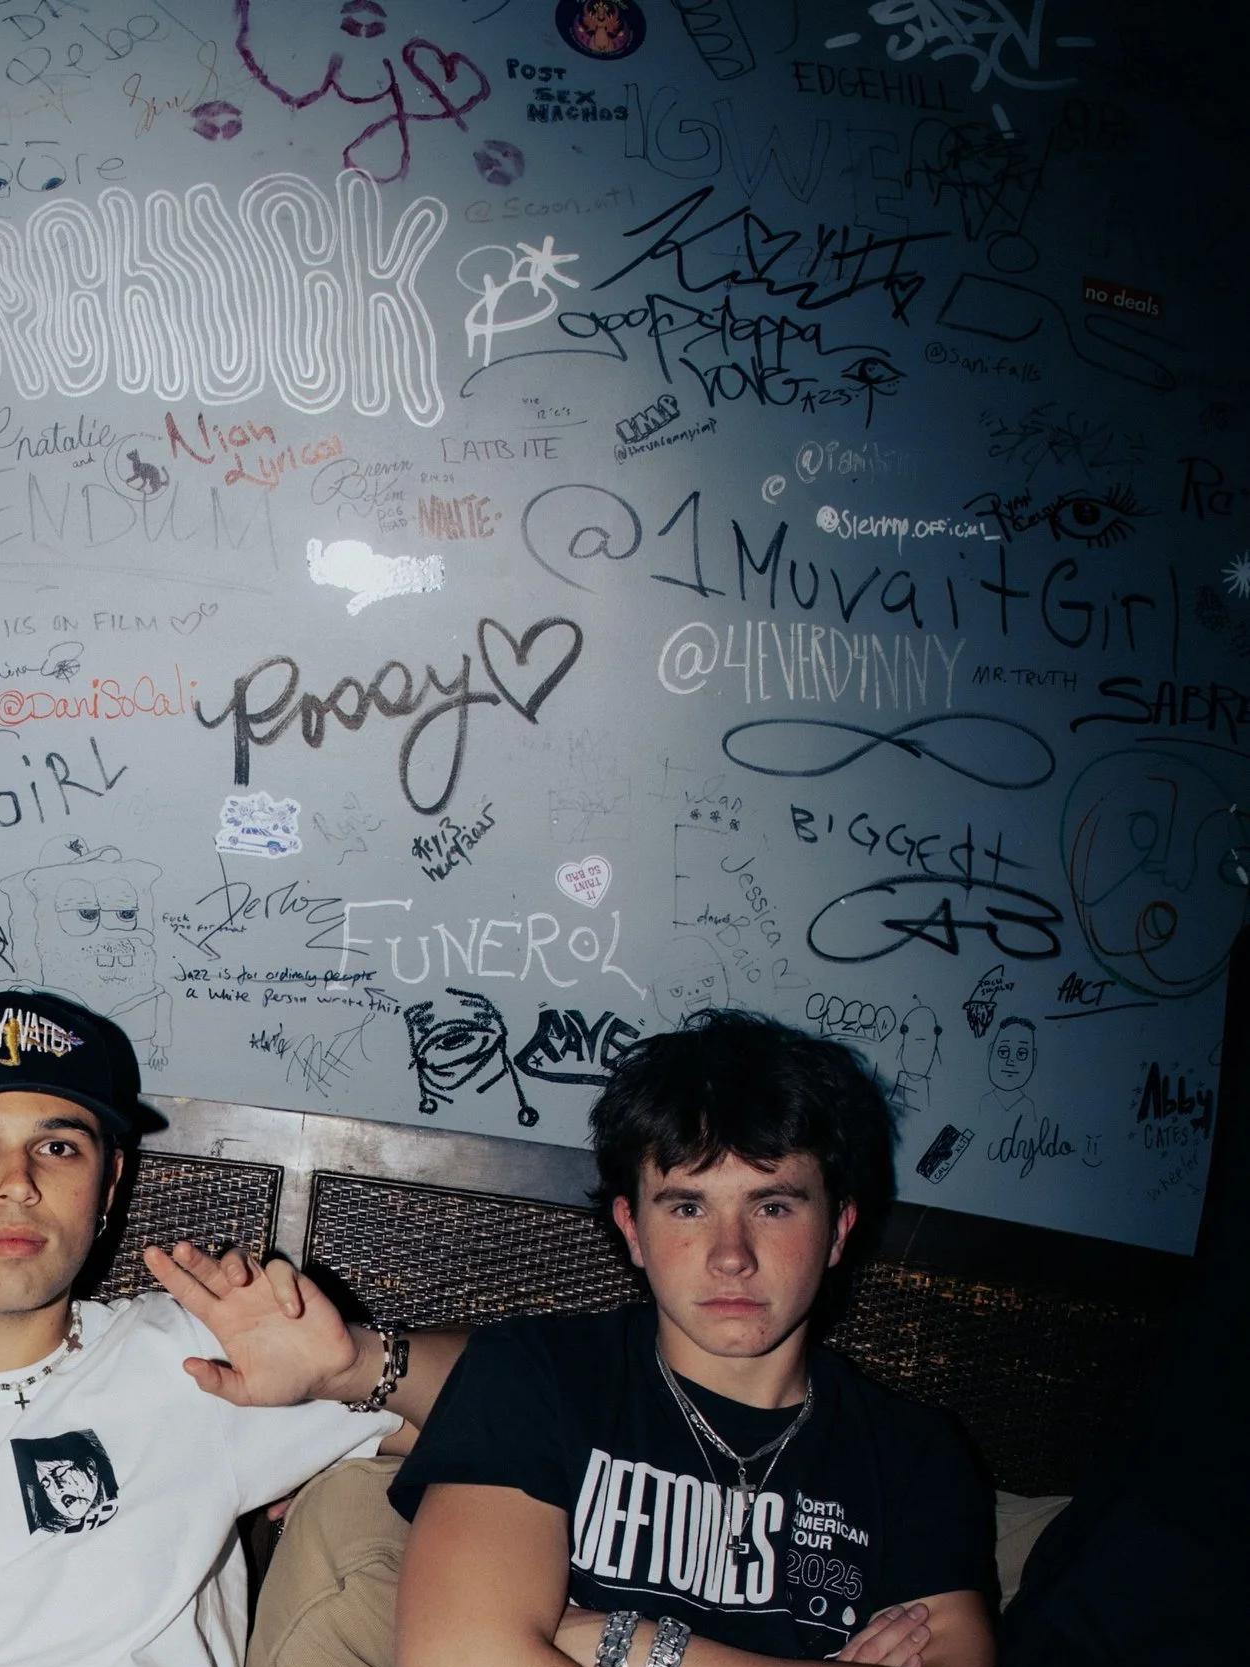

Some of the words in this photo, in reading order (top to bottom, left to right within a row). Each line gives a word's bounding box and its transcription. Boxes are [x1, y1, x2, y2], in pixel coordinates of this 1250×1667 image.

[506, 57, 566, 81] POST
[793, 60, 963, 114] EDGEHILL
[527, 103, 628, 123] NACHOS
[533, 87, 596, 105] SEX
[1085, 285, 1108, 302] no
[1113, 288, 1160, 316] deals
[616, 395, 681, 446] IMP
[972, 665, 1006, 685] MR.
[1010, 668, 1078, 692] TRUTH
[1136, 1061, 1213, 1139] Abby
[571, 1447, 785, 1605] DEFTONES
[786, 1548, 863, 1600] 2025
